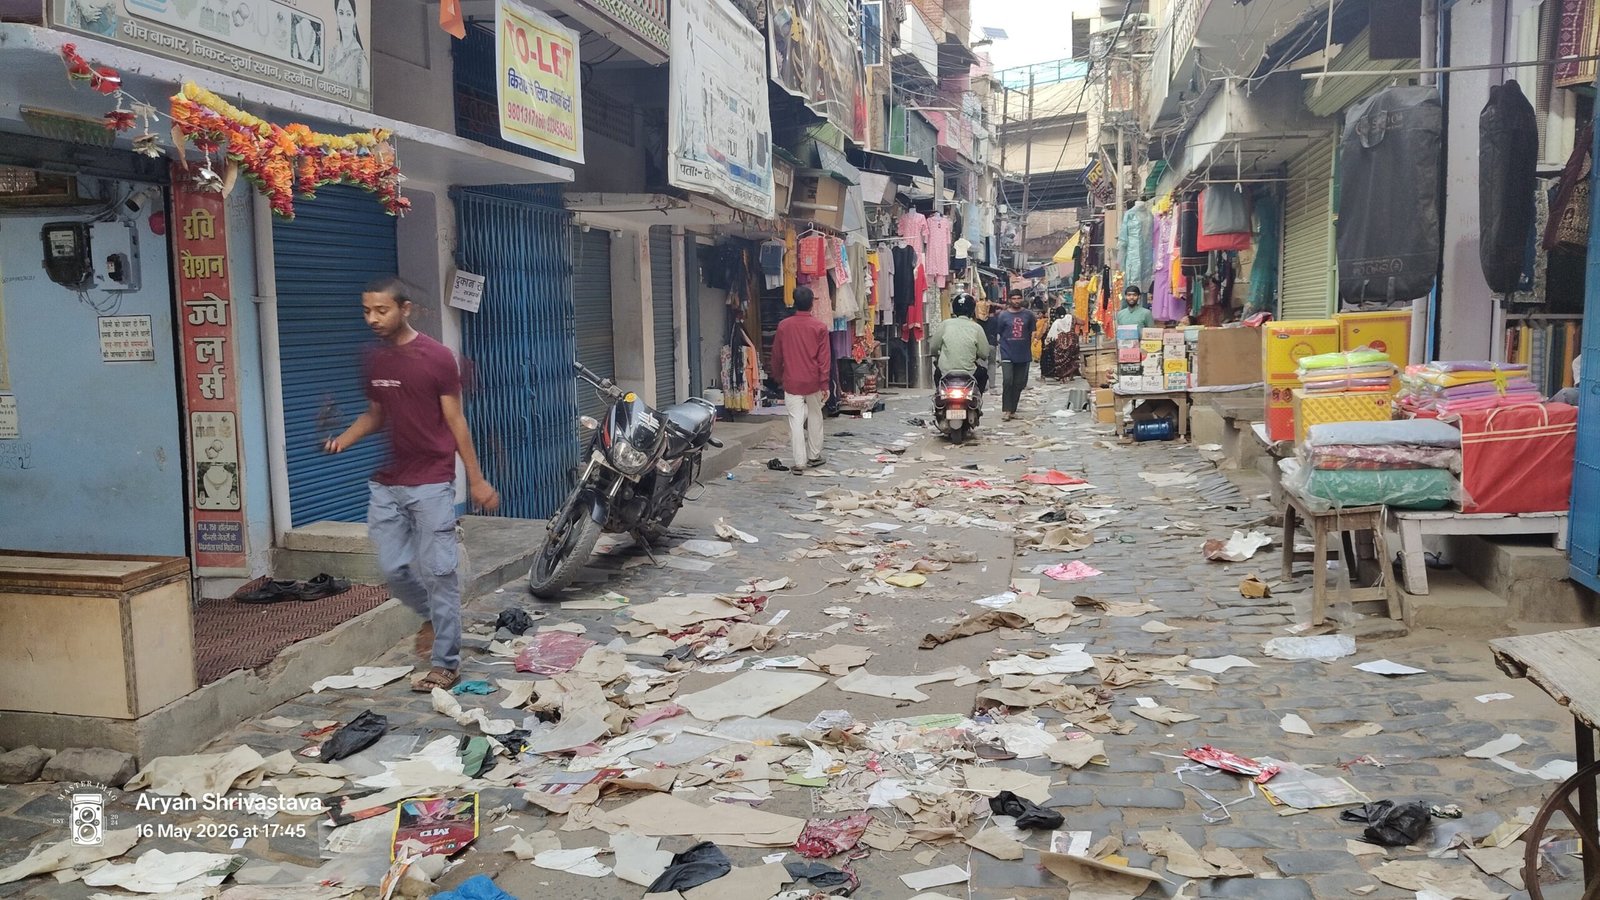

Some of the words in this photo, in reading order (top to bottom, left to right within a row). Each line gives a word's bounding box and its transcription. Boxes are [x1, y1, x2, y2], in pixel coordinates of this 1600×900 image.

[123, 20, 149, 40] बीच
[150, 31, 191, 54] बाजार,
[505, 18, 571, 82] TO-LET
[182, 208, 215, 240] रवि
[455, 276, 476, 289] दुकान
